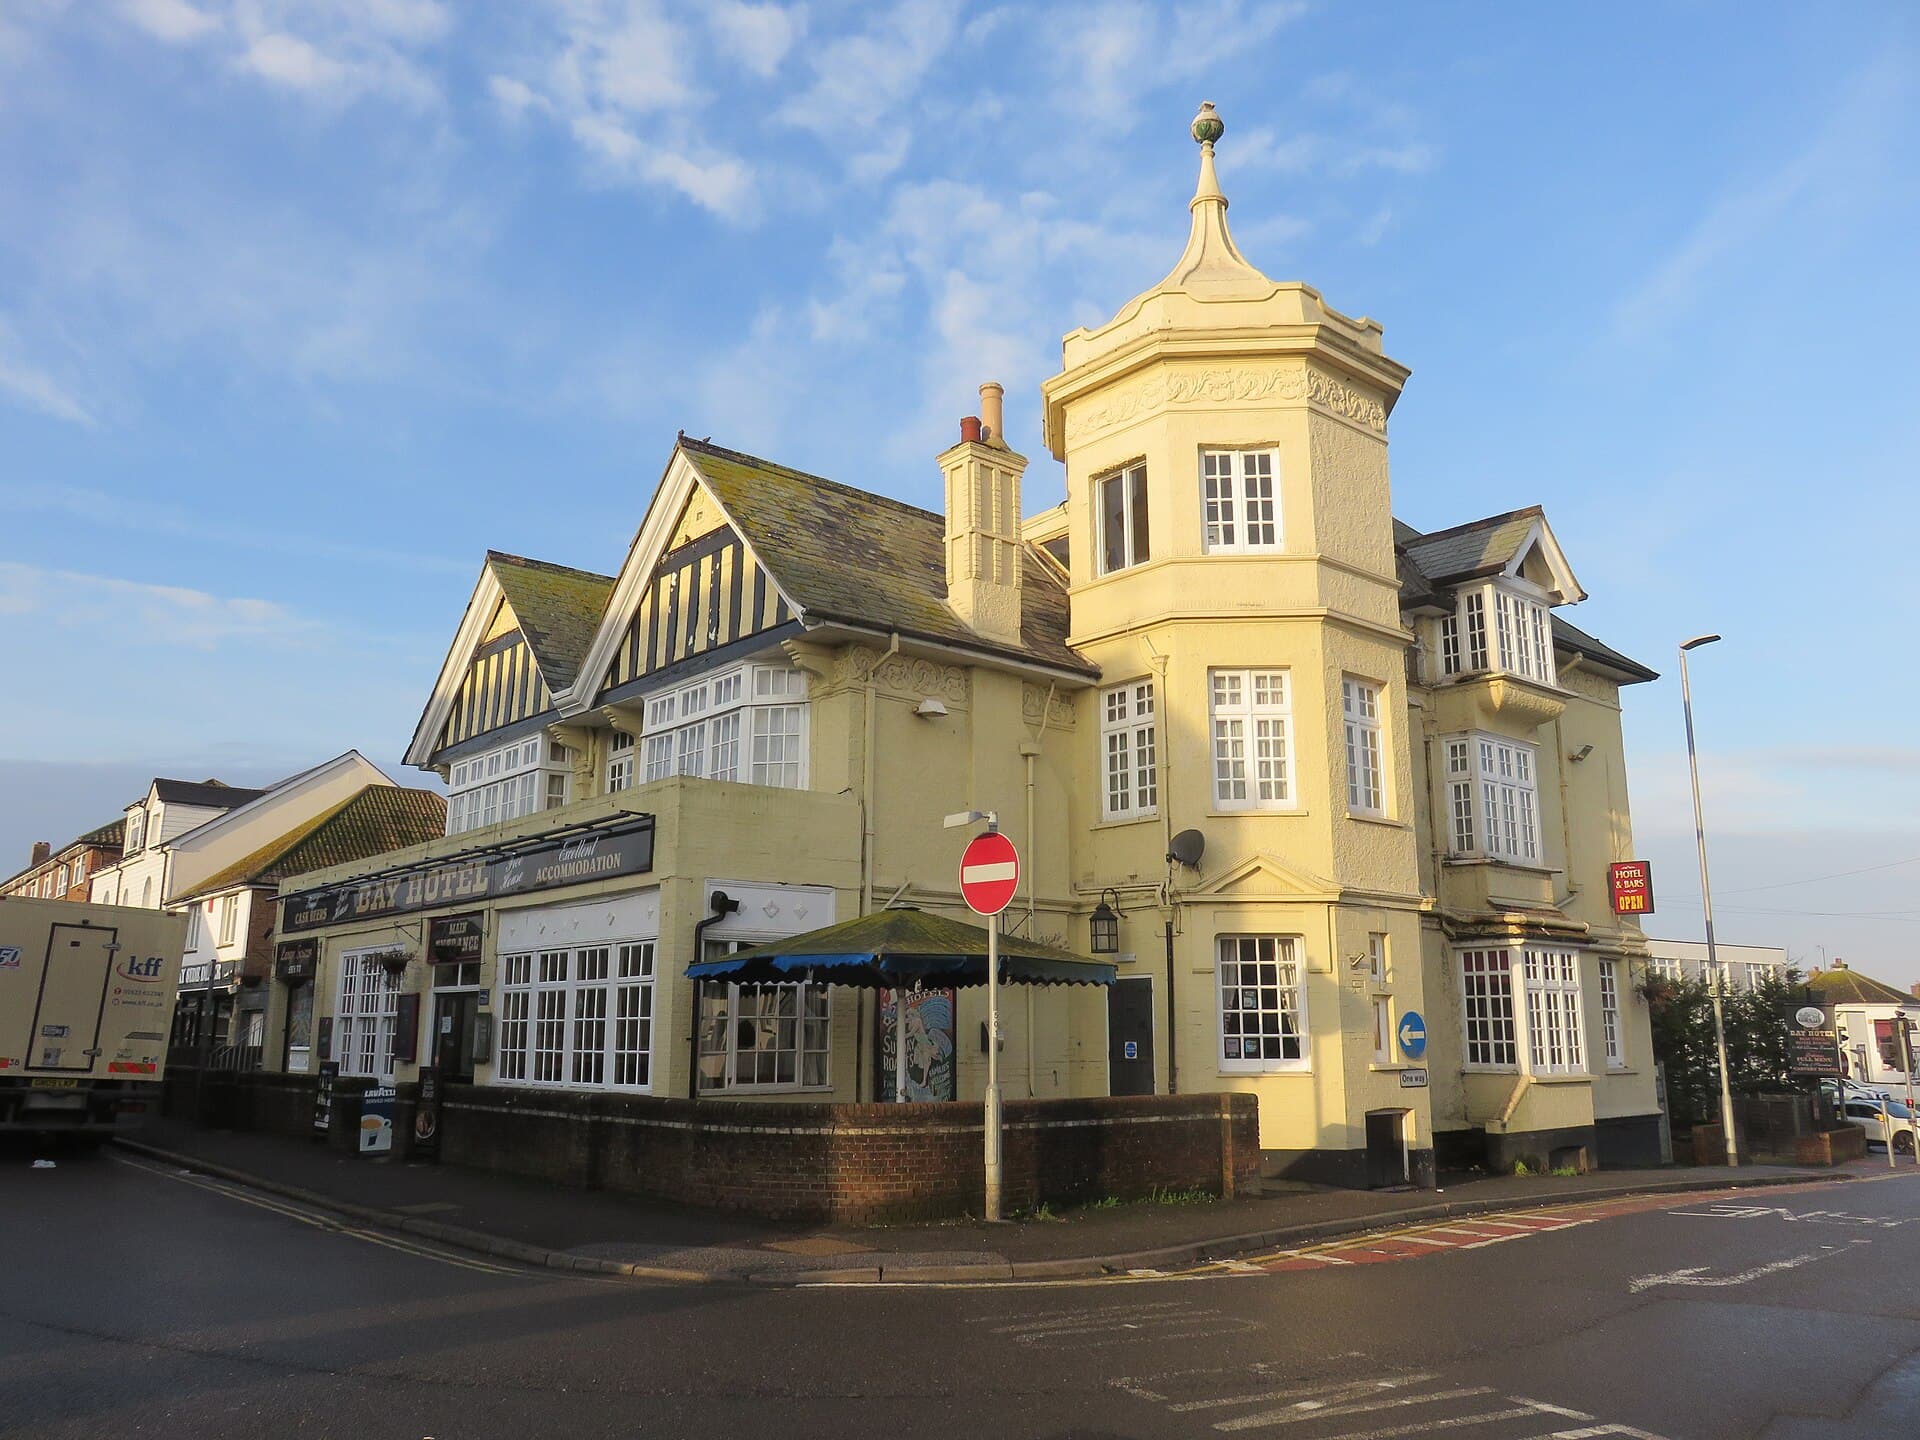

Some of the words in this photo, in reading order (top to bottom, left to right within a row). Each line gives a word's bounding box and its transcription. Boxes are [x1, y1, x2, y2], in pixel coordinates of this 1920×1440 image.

[559, 836, 600, 861] Excellent
[535, 852, 622, 883] ACCOMMODATION
[1615, 869, 1644, 879] HOTEL
[356, 878, 402, 913] BAY
[406, 861, 489, 905] HOTEL
[500, 871, 524, 890] House
[1615, 881, 1622, 889] &
[1624, 879, 1645, 889] BARS
[1619, 895, 1644, 911] OPEN
[295, 912, 309, 924] CASK
[309, 908, 328, 922] BEERS
[449, 921, 468, 935] MAIN
[127, 956, 163, 977] kff
[882, 1035, 916, 1055] SUAY
[883, 1054, 915, 1072] ROTS
[1402, 1074, 1413, 1083] One
[1414, 1075, 1425, 1084] way
